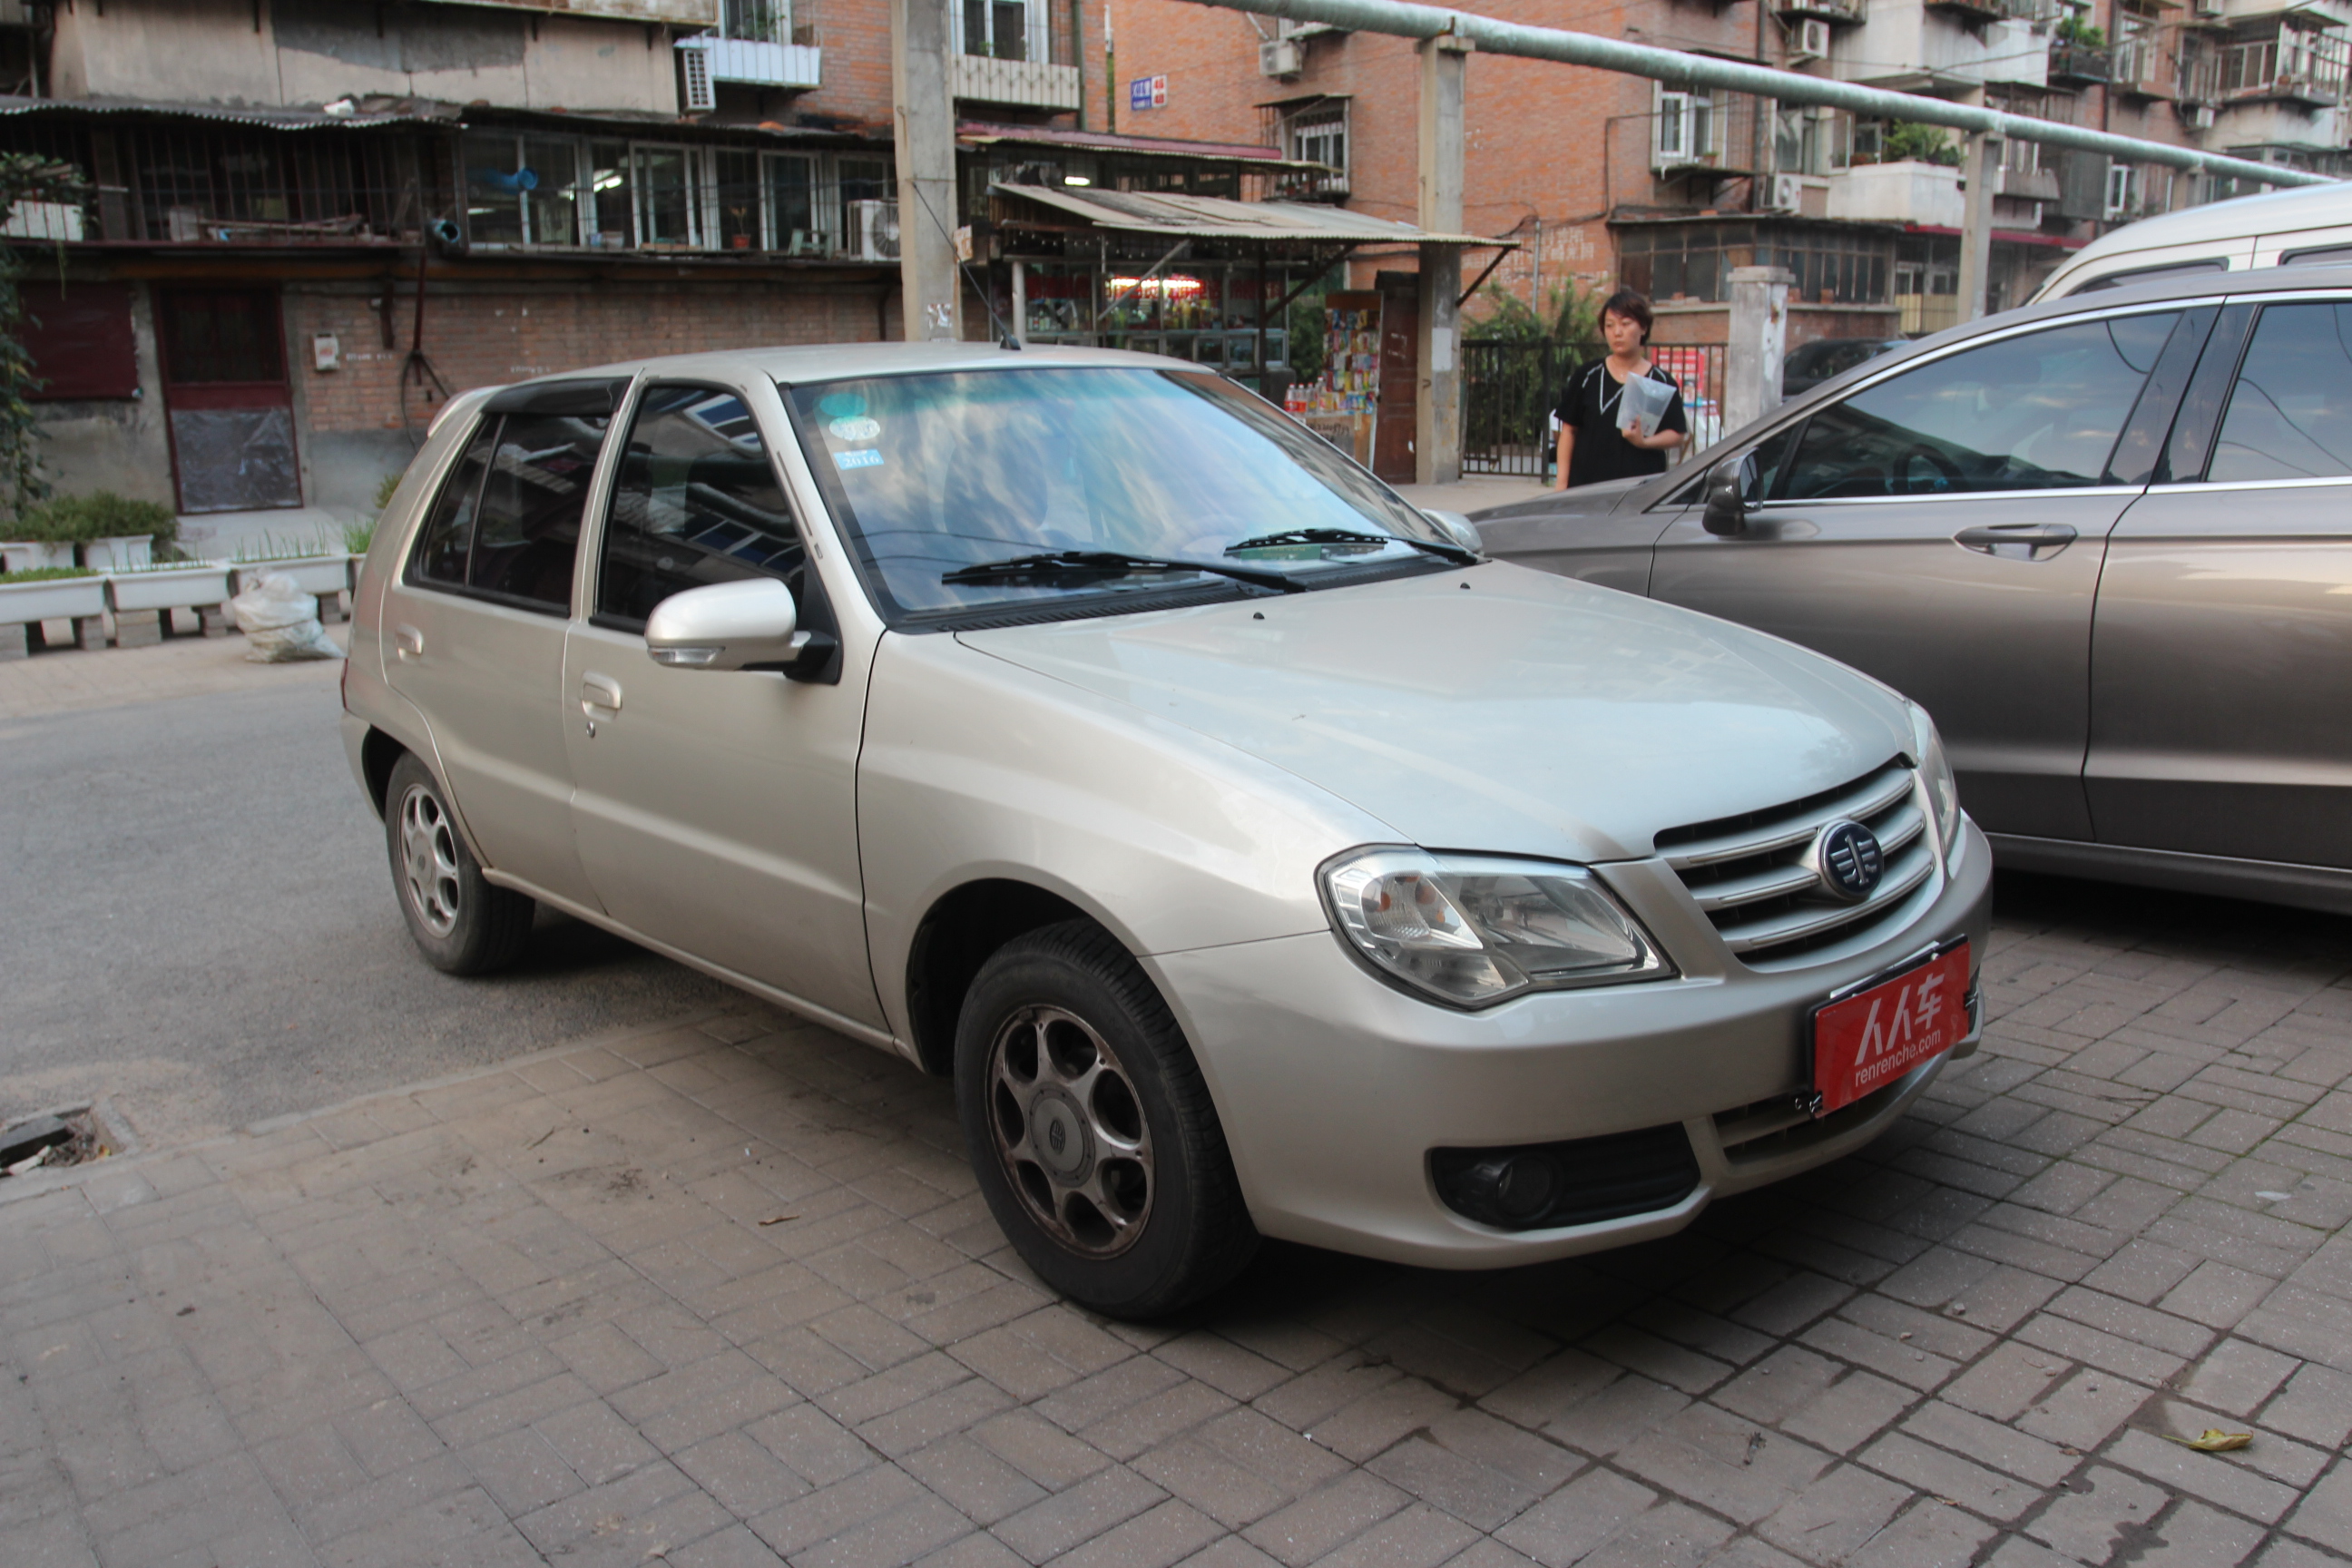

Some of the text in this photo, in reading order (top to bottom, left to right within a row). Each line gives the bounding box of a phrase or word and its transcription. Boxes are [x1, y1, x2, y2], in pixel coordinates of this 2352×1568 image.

[843, 456, 879, 467] 2016
[1854, 972, 1945, 1067] 人人车
[1854, 1028, 1942, 1088] renrenche.com
